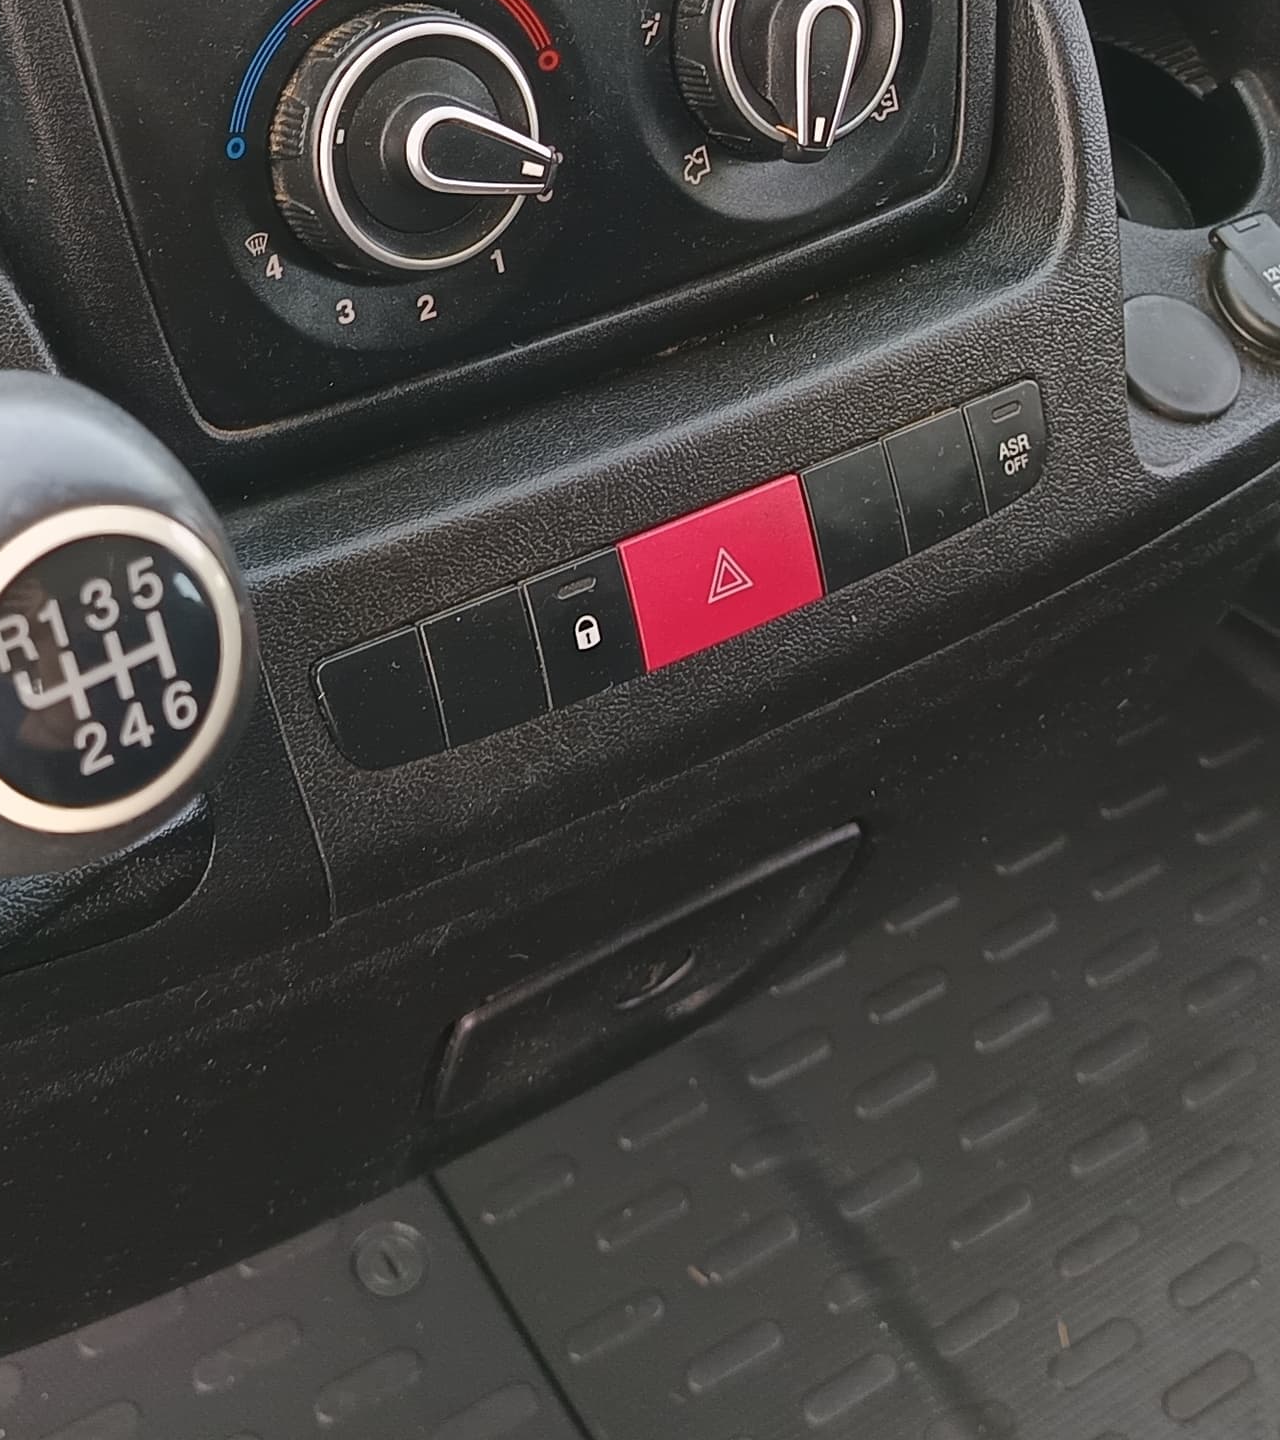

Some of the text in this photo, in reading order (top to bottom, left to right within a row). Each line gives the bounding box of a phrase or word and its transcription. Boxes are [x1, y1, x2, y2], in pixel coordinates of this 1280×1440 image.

[265, 255, 283, 279] 4
[490, 249, 505, 273] 1
[335, 298, 356, 324] 3
[416, 294, 437, 322] 2
[999, 434, 1031, 461] ASR
[1004, 454, 1030, 475] OFF
[38, 599, 69, 647] 1
[80, 578, 119, 630] 3
[127, 557, 163, 609] 5
[74, 680, 198, 776] 2 4 6
